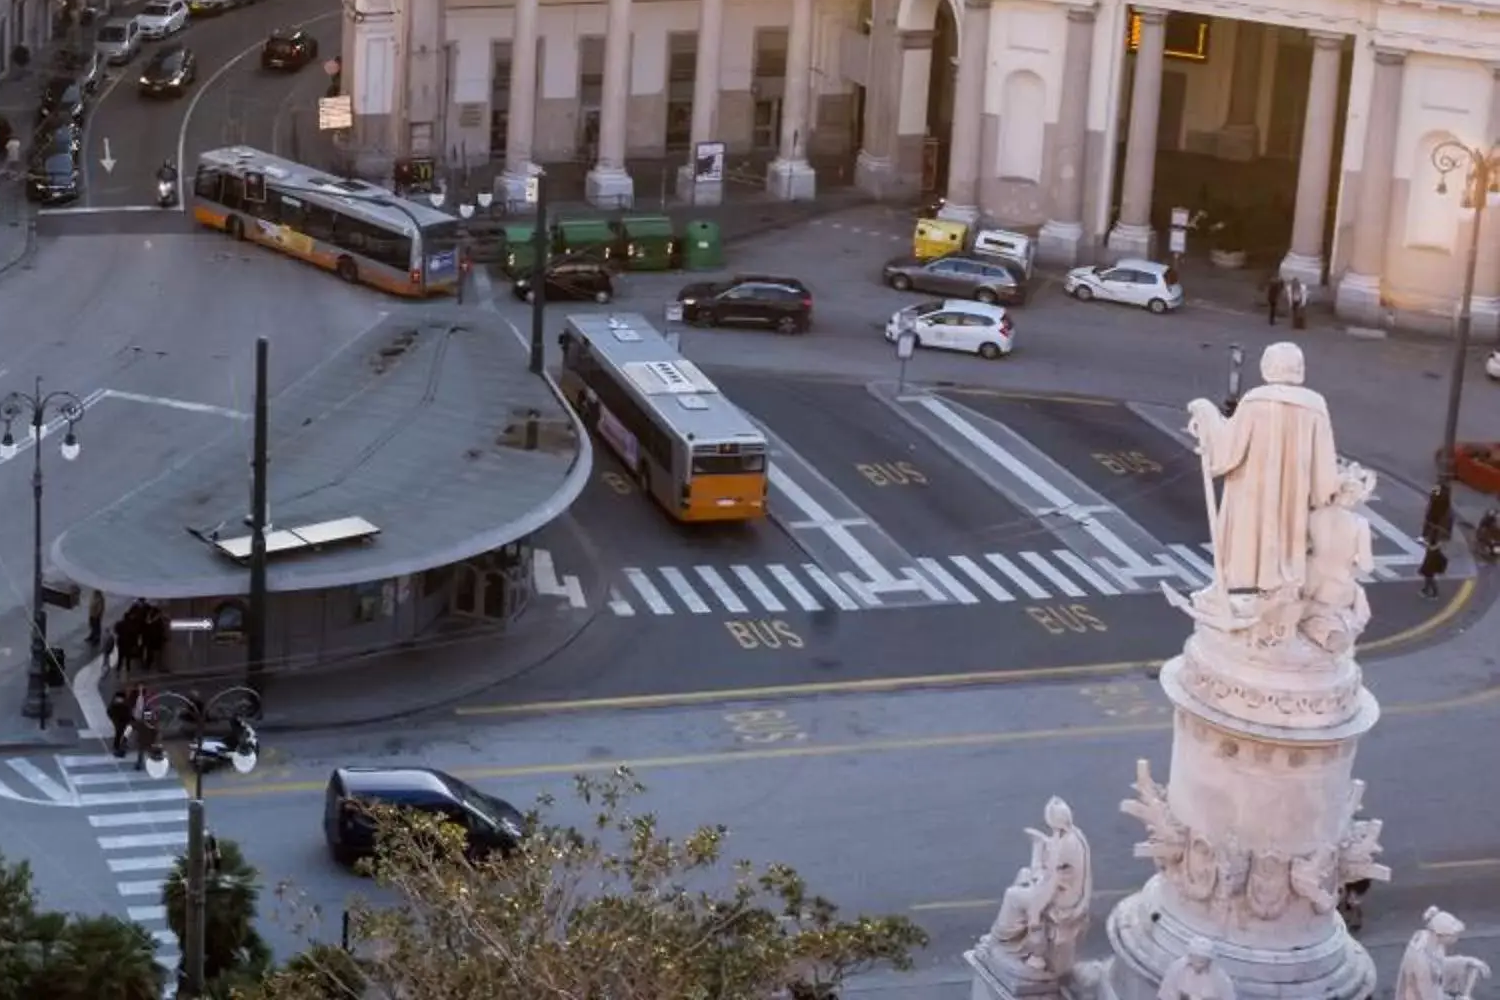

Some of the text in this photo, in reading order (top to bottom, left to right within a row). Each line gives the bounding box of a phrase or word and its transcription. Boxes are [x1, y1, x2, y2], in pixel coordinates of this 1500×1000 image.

[856, 461, 929, 486] BUS
[1091, 451, 1163, 474] BUS
[1025, 604, 1108, 634] BUS
[723, 620, 804, 648] BUS
